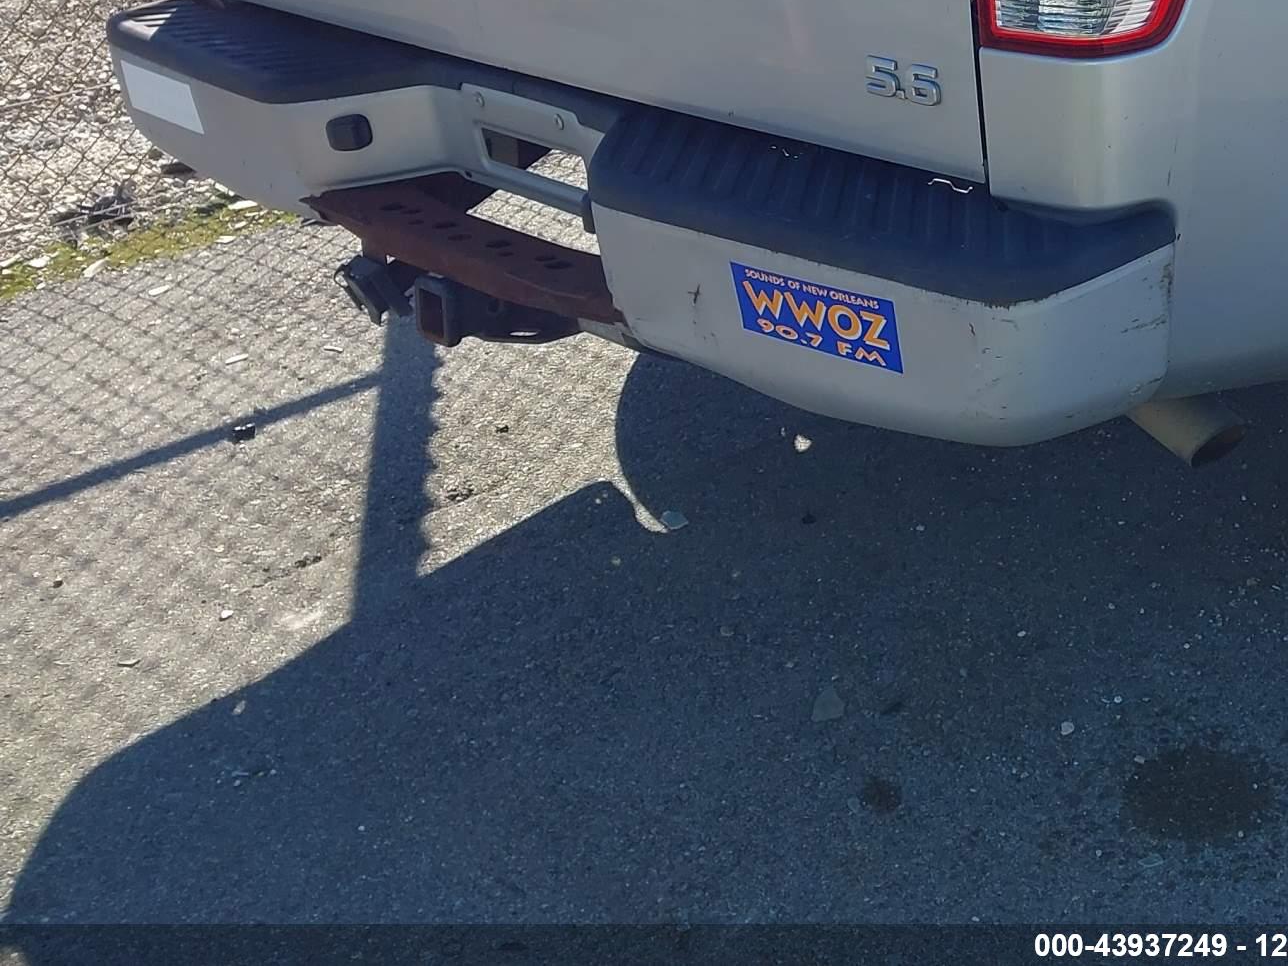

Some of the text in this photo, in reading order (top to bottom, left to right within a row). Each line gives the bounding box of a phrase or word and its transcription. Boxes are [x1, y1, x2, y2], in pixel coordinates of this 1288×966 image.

[865, 54, 942, 107] 5.6
[744, 268, 880, 310] SOUNDS OF NEW ORLEANS
[742, 280, 891, 351] WWOZ
[756, 317, 887, 367] 90.7 FM
